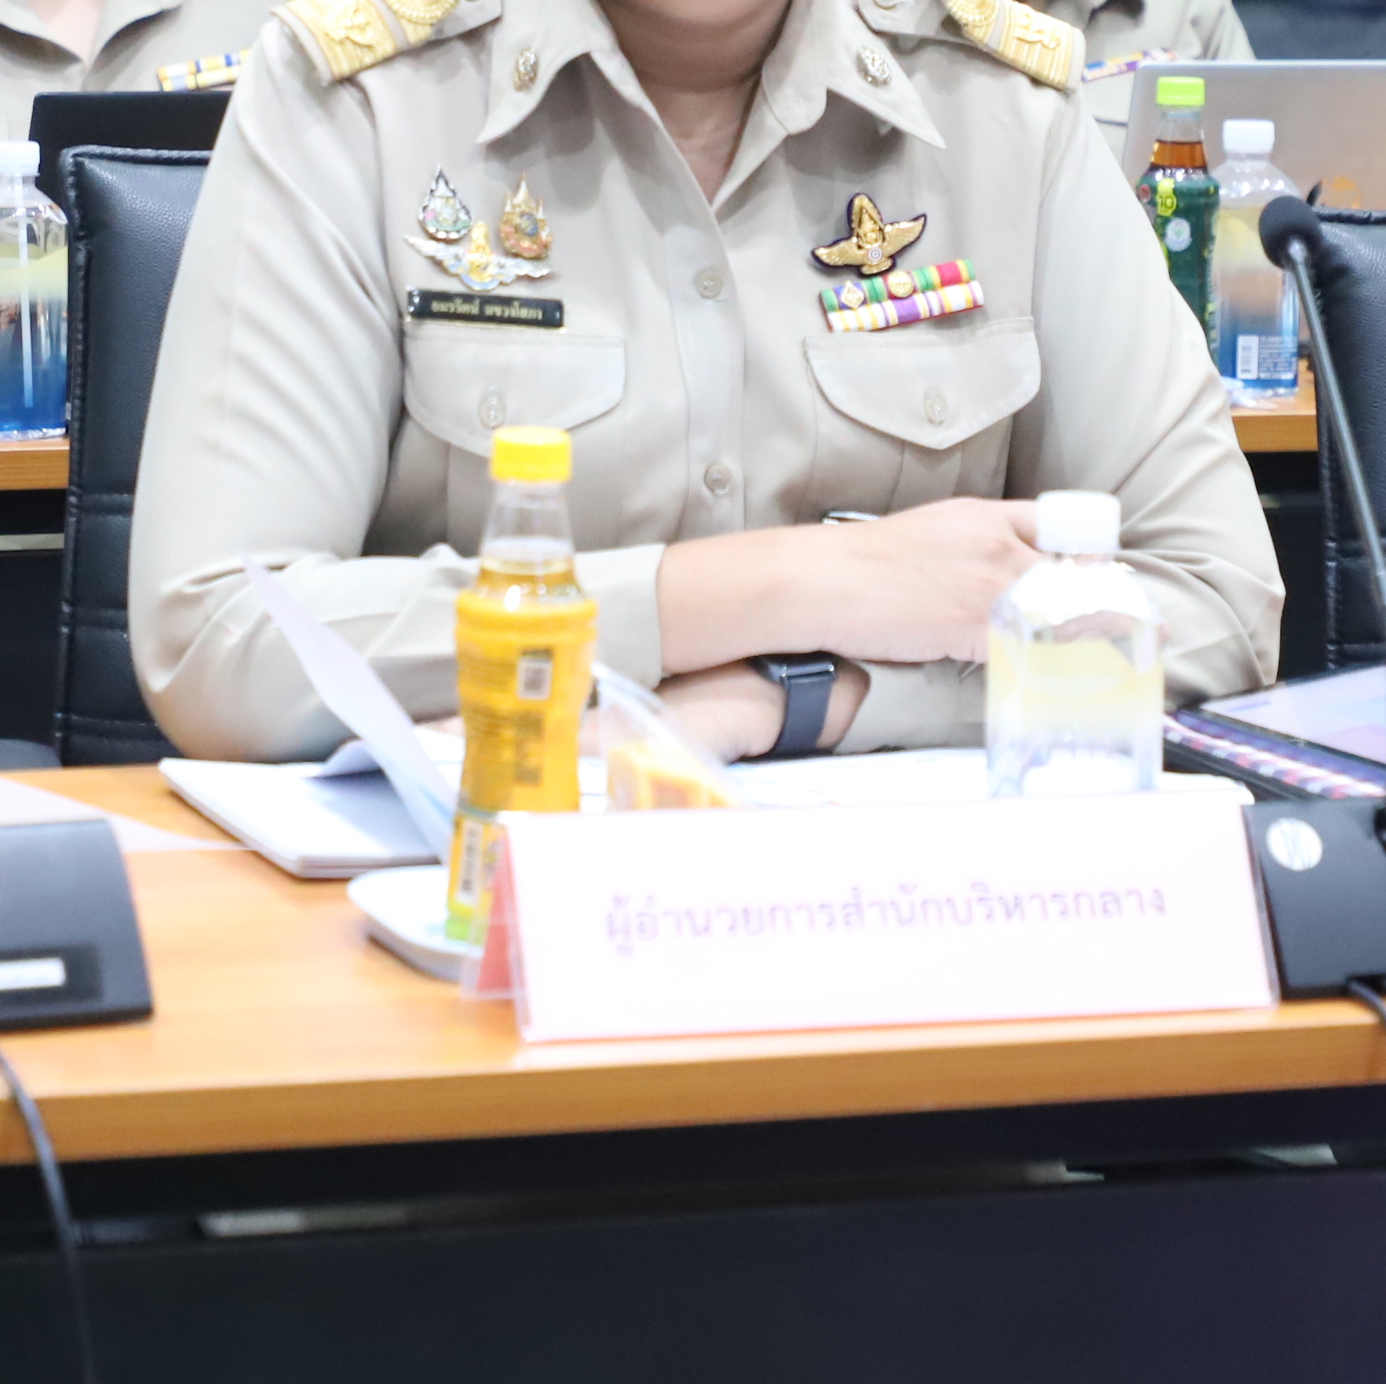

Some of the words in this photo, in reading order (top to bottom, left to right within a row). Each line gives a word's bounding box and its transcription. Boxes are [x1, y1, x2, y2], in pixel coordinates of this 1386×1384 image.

[603, 879, 1169, 959] ผู้อำนวยการสำนักบริหารกลาง
